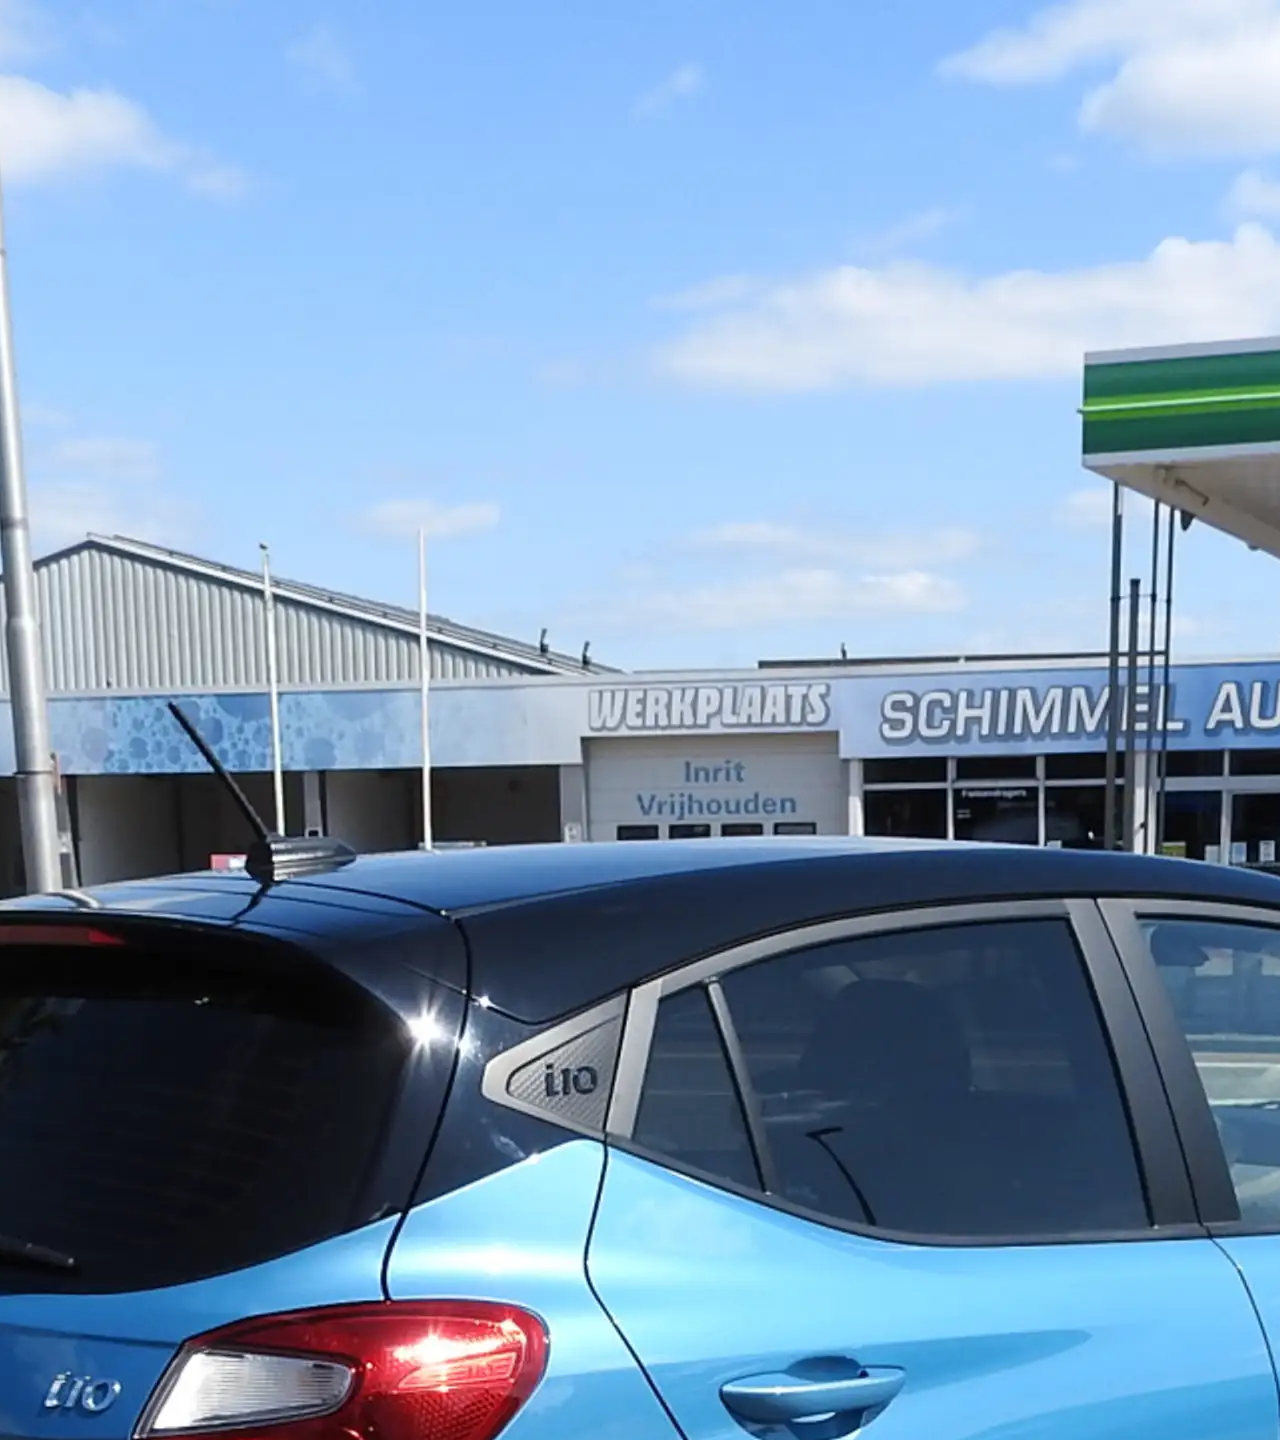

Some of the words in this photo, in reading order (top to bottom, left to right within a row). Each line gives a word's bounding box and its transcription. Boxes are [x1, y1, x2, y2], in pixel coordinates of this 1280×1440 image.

[588, 682, 831, 731] WERKPLAATS
[879, 684, 1186, 740] SCHIMMEL
[683, 759, 747, 784] Inrit
[636, 791, 797, 822] Vrijhouden
[545, 1062, 598, 1098] i10
[43, 1370, 122, 1412] i10
